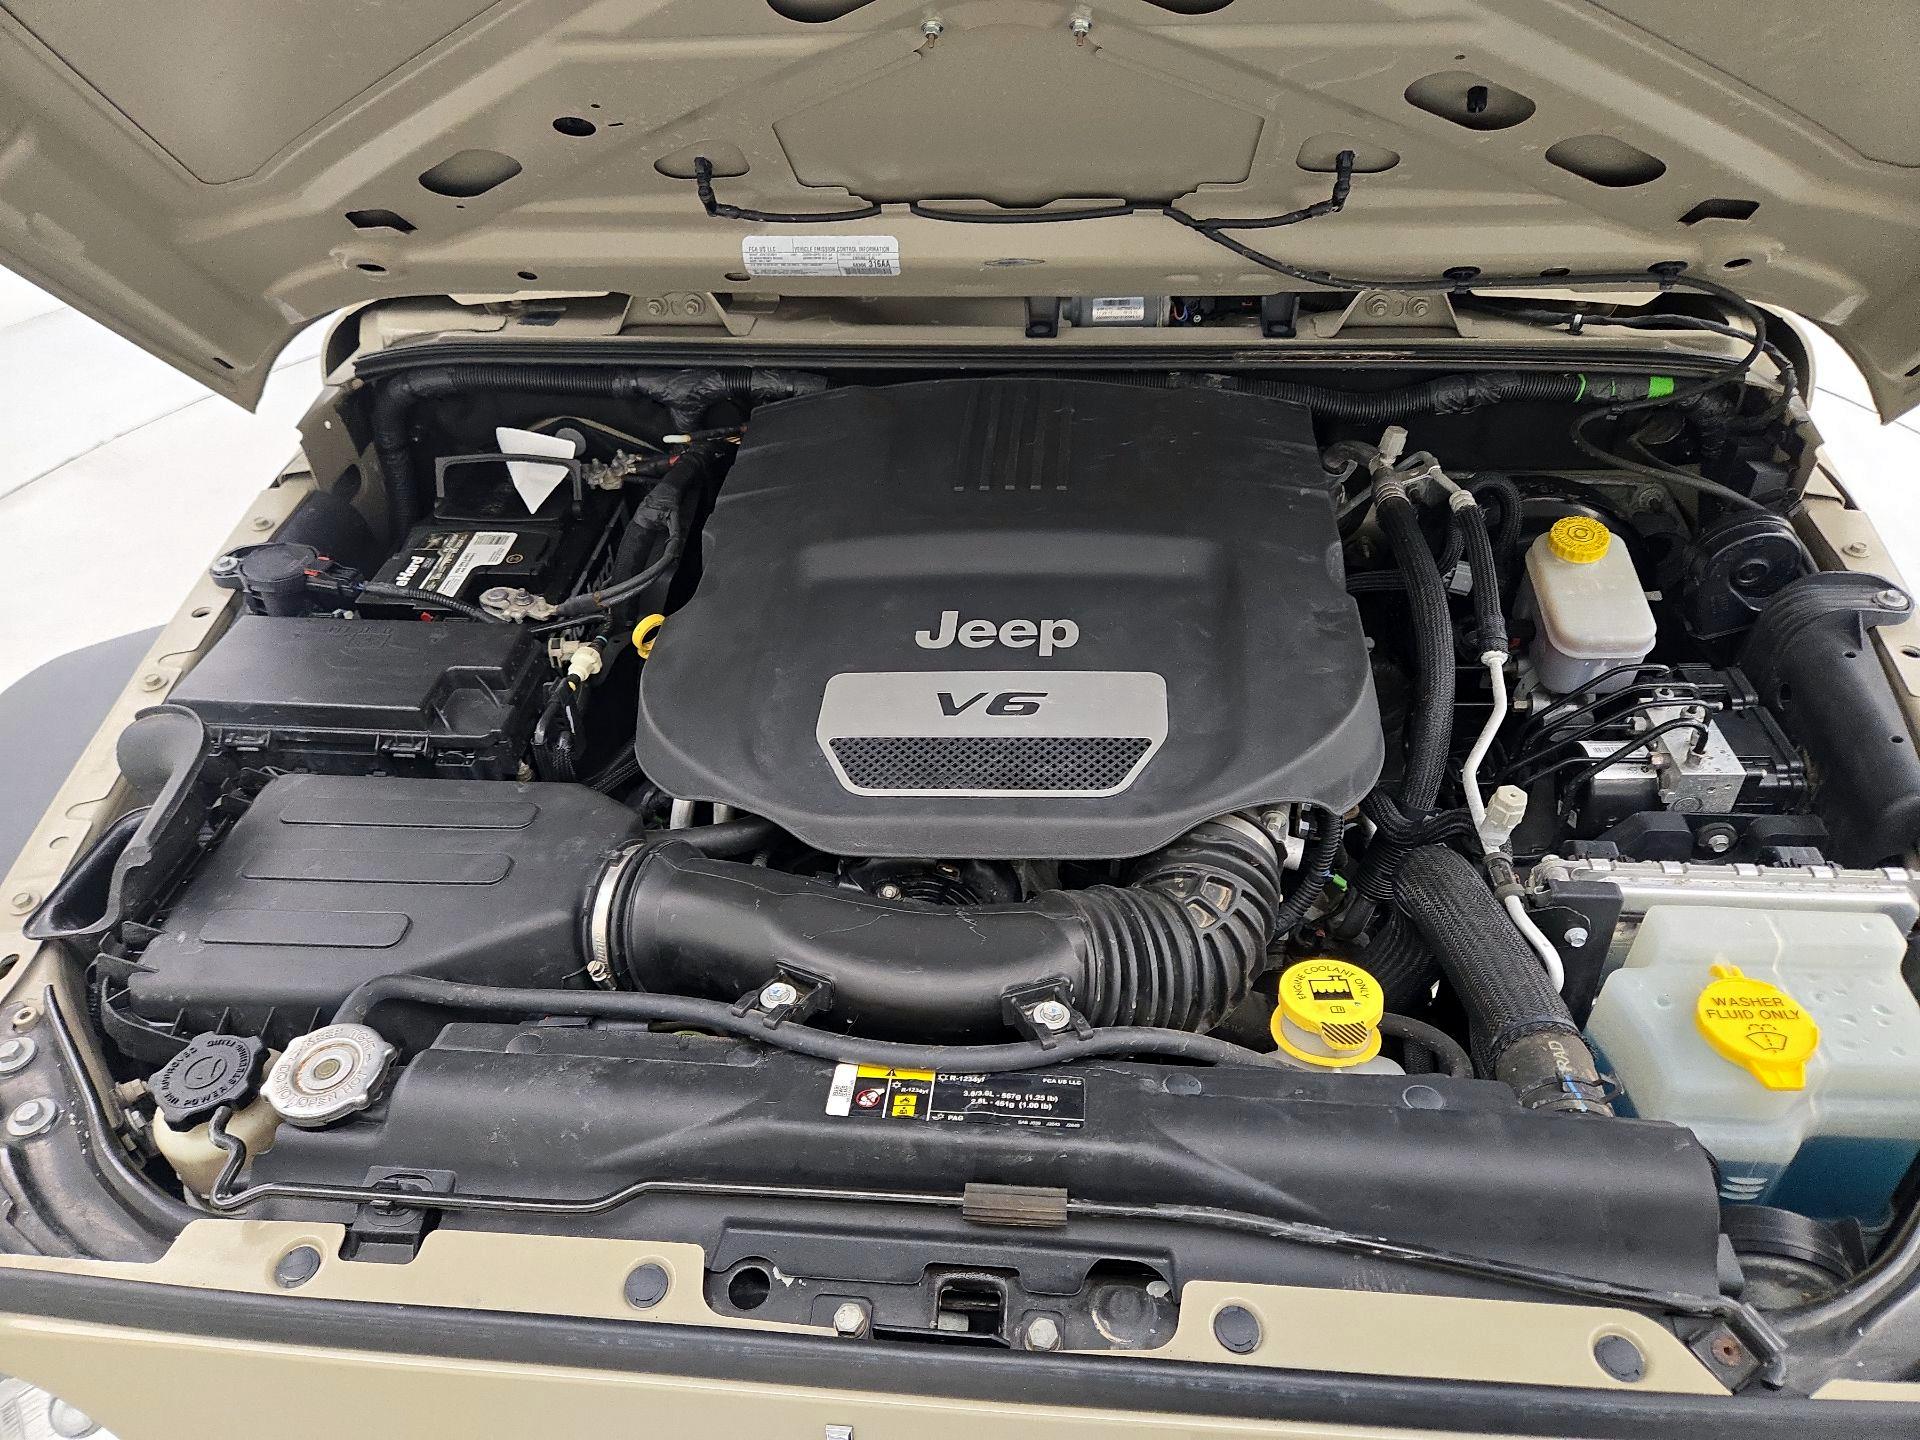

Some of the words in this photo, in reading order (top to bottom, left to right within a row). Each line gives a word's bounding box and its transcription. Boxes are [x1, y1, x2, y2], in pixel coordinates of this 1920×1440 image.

[396, 556, 426, 586] eHard
[915, 610, 1080, 656] Jeep
[937, 692, 1048, 716] V6
[1293, 974, 1306, 1000] ENGINE
[1304, 966, 1356, 978] COOLANT
[1354, 978, 1370, 998] ONLY
[1712, 997, 1784, 1006] WASHER
[1706, 1009, 1754, 1019] FLUID
[1760, 1009, 1800, 1020] ONLY
[1548, 1041, 1572, 1072] RAD
[298, 1092, 338, 1108] OPEN
[344, 1070, 367, 1094] HOT
[950, 1074, 986, 1084] R-1234yf
[184, 1086, 228, 1106] POWER
[994, 1100, 1015, 1109] 451g
[1018, 1102, 1040, 1110] (1.00
[1040, 1102, 1052, 1111] lb)
[1001, 1092, 1022, 1101] 567g
[1025, 1094, 1046, 1102] (1.25
[1046, 1094, 1058, 1103] lb)
